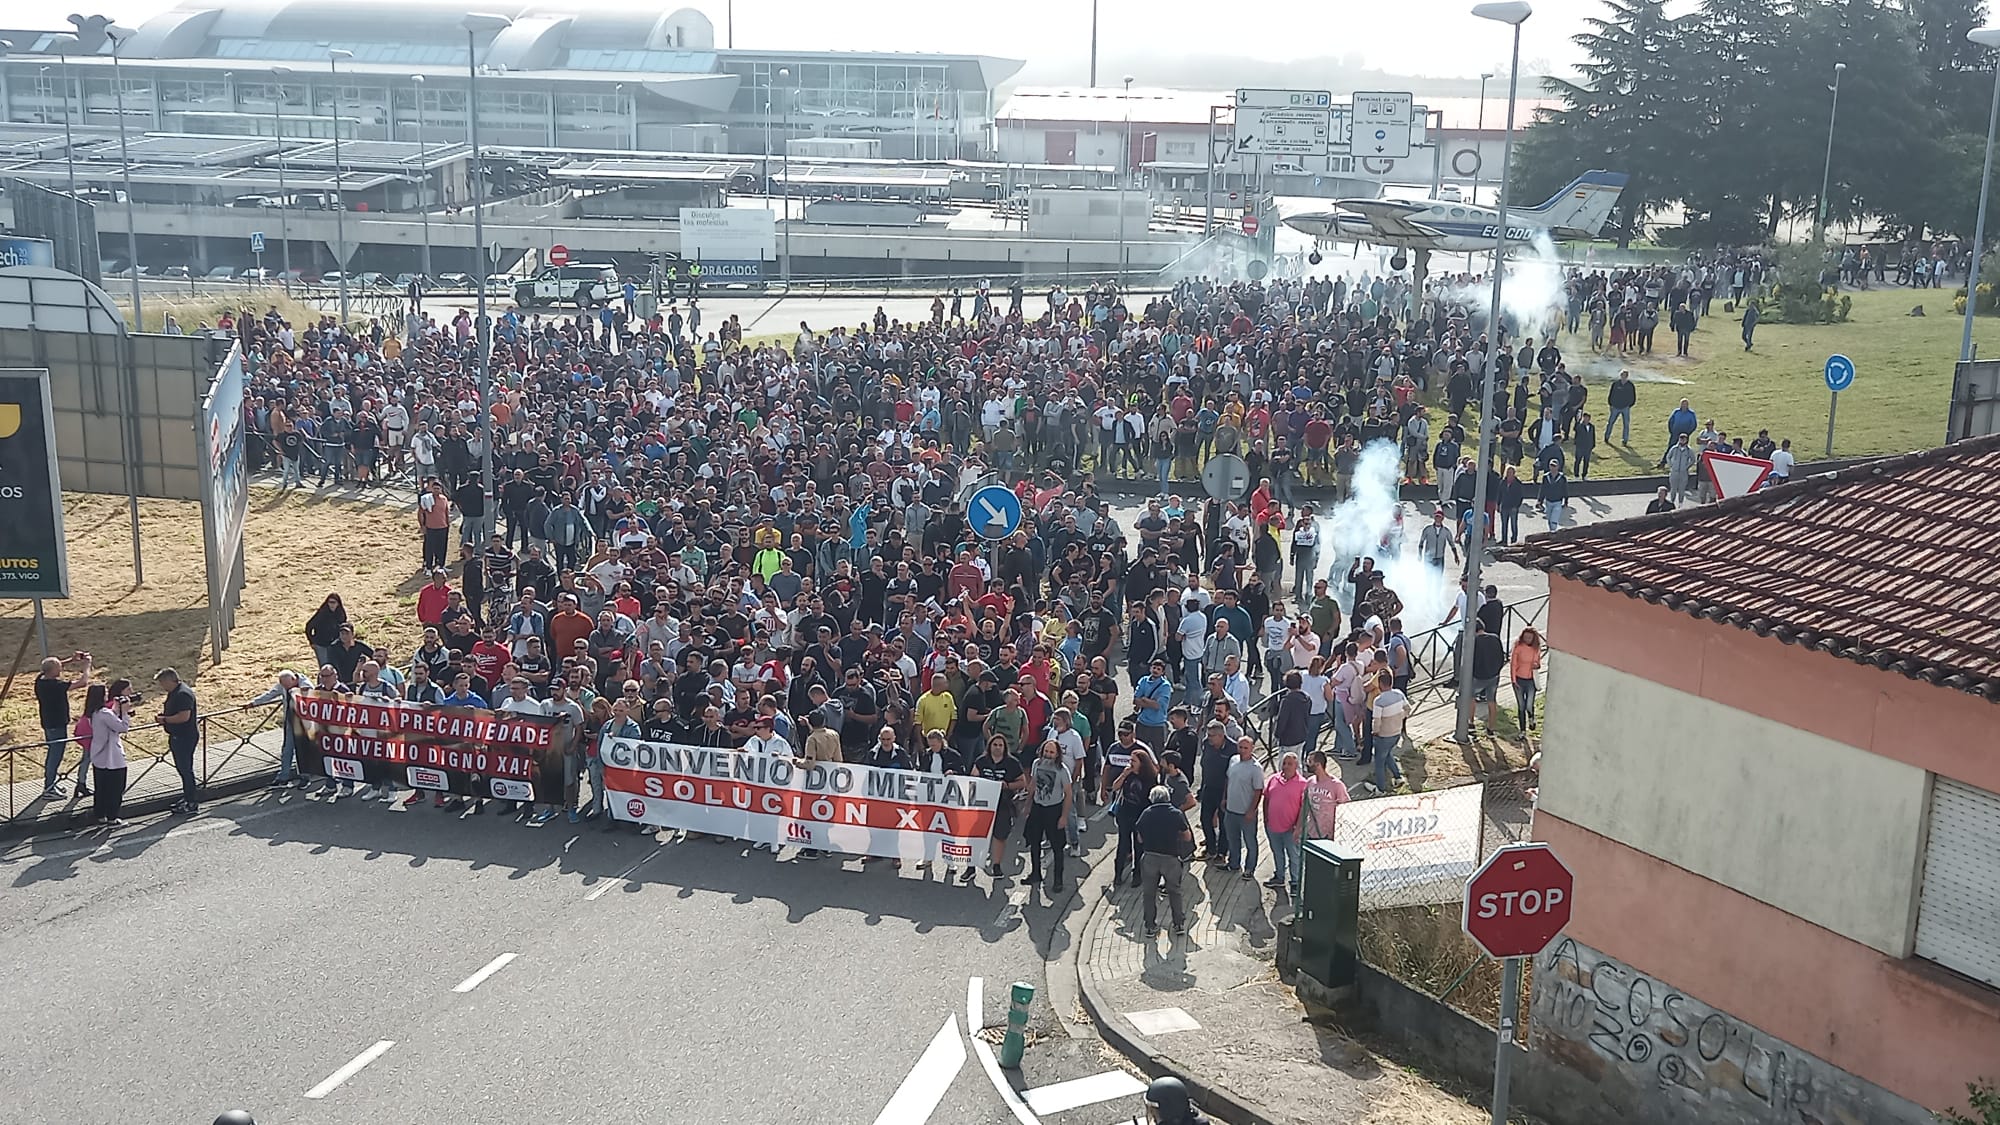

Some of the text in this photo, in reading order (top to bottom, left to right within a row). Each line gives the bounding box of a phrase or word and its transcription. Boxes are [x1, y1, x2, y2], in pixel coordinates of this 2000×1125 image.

[701, 265, 758, 276] DRAGADOS
[0, 486, 23, 498] OS
[0, 559, 39, 569] UTOS
[19, 572, 40, 580] VIGO
[300, 700, 550, 746] CONTRA A PRECARIEDADE
[322, 735, 530, 776] CONVENIO DIGNO XA!
[610, 741, 989, 808] CONVENIO DO METAL
[644, 777, 951, 834] SOLUCIÓN XA
[1477, 888, 1564, 919] STOP
[1549, 938, 1727, 1061] ACOSO
